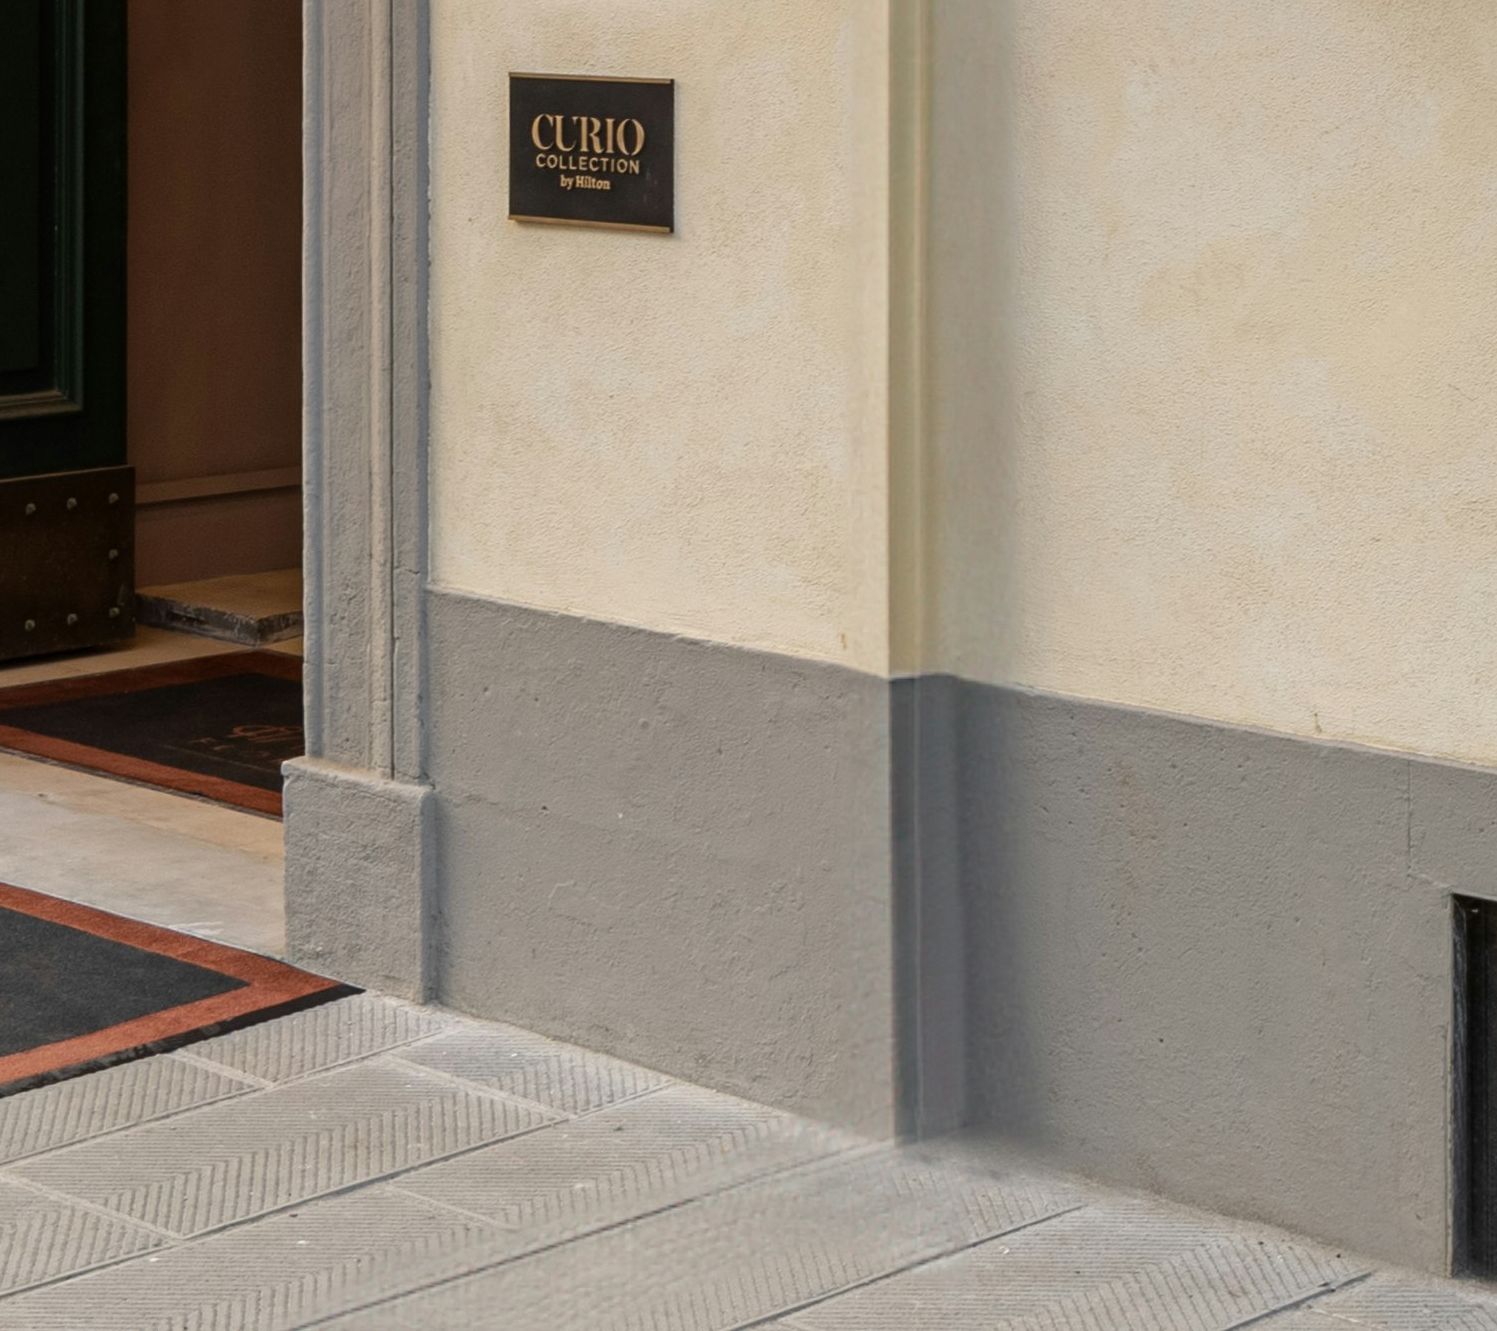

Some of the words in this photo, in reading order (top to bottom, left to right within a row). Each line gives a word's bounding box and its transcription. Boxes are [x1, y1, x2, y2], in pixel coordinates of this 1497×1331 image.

[531, 114, 645, 156] CURIO
[536, 153, 640, 174] COLLECTION
[560, 174, 574, 190] by
[575, 175, 611, 190] Hilton
